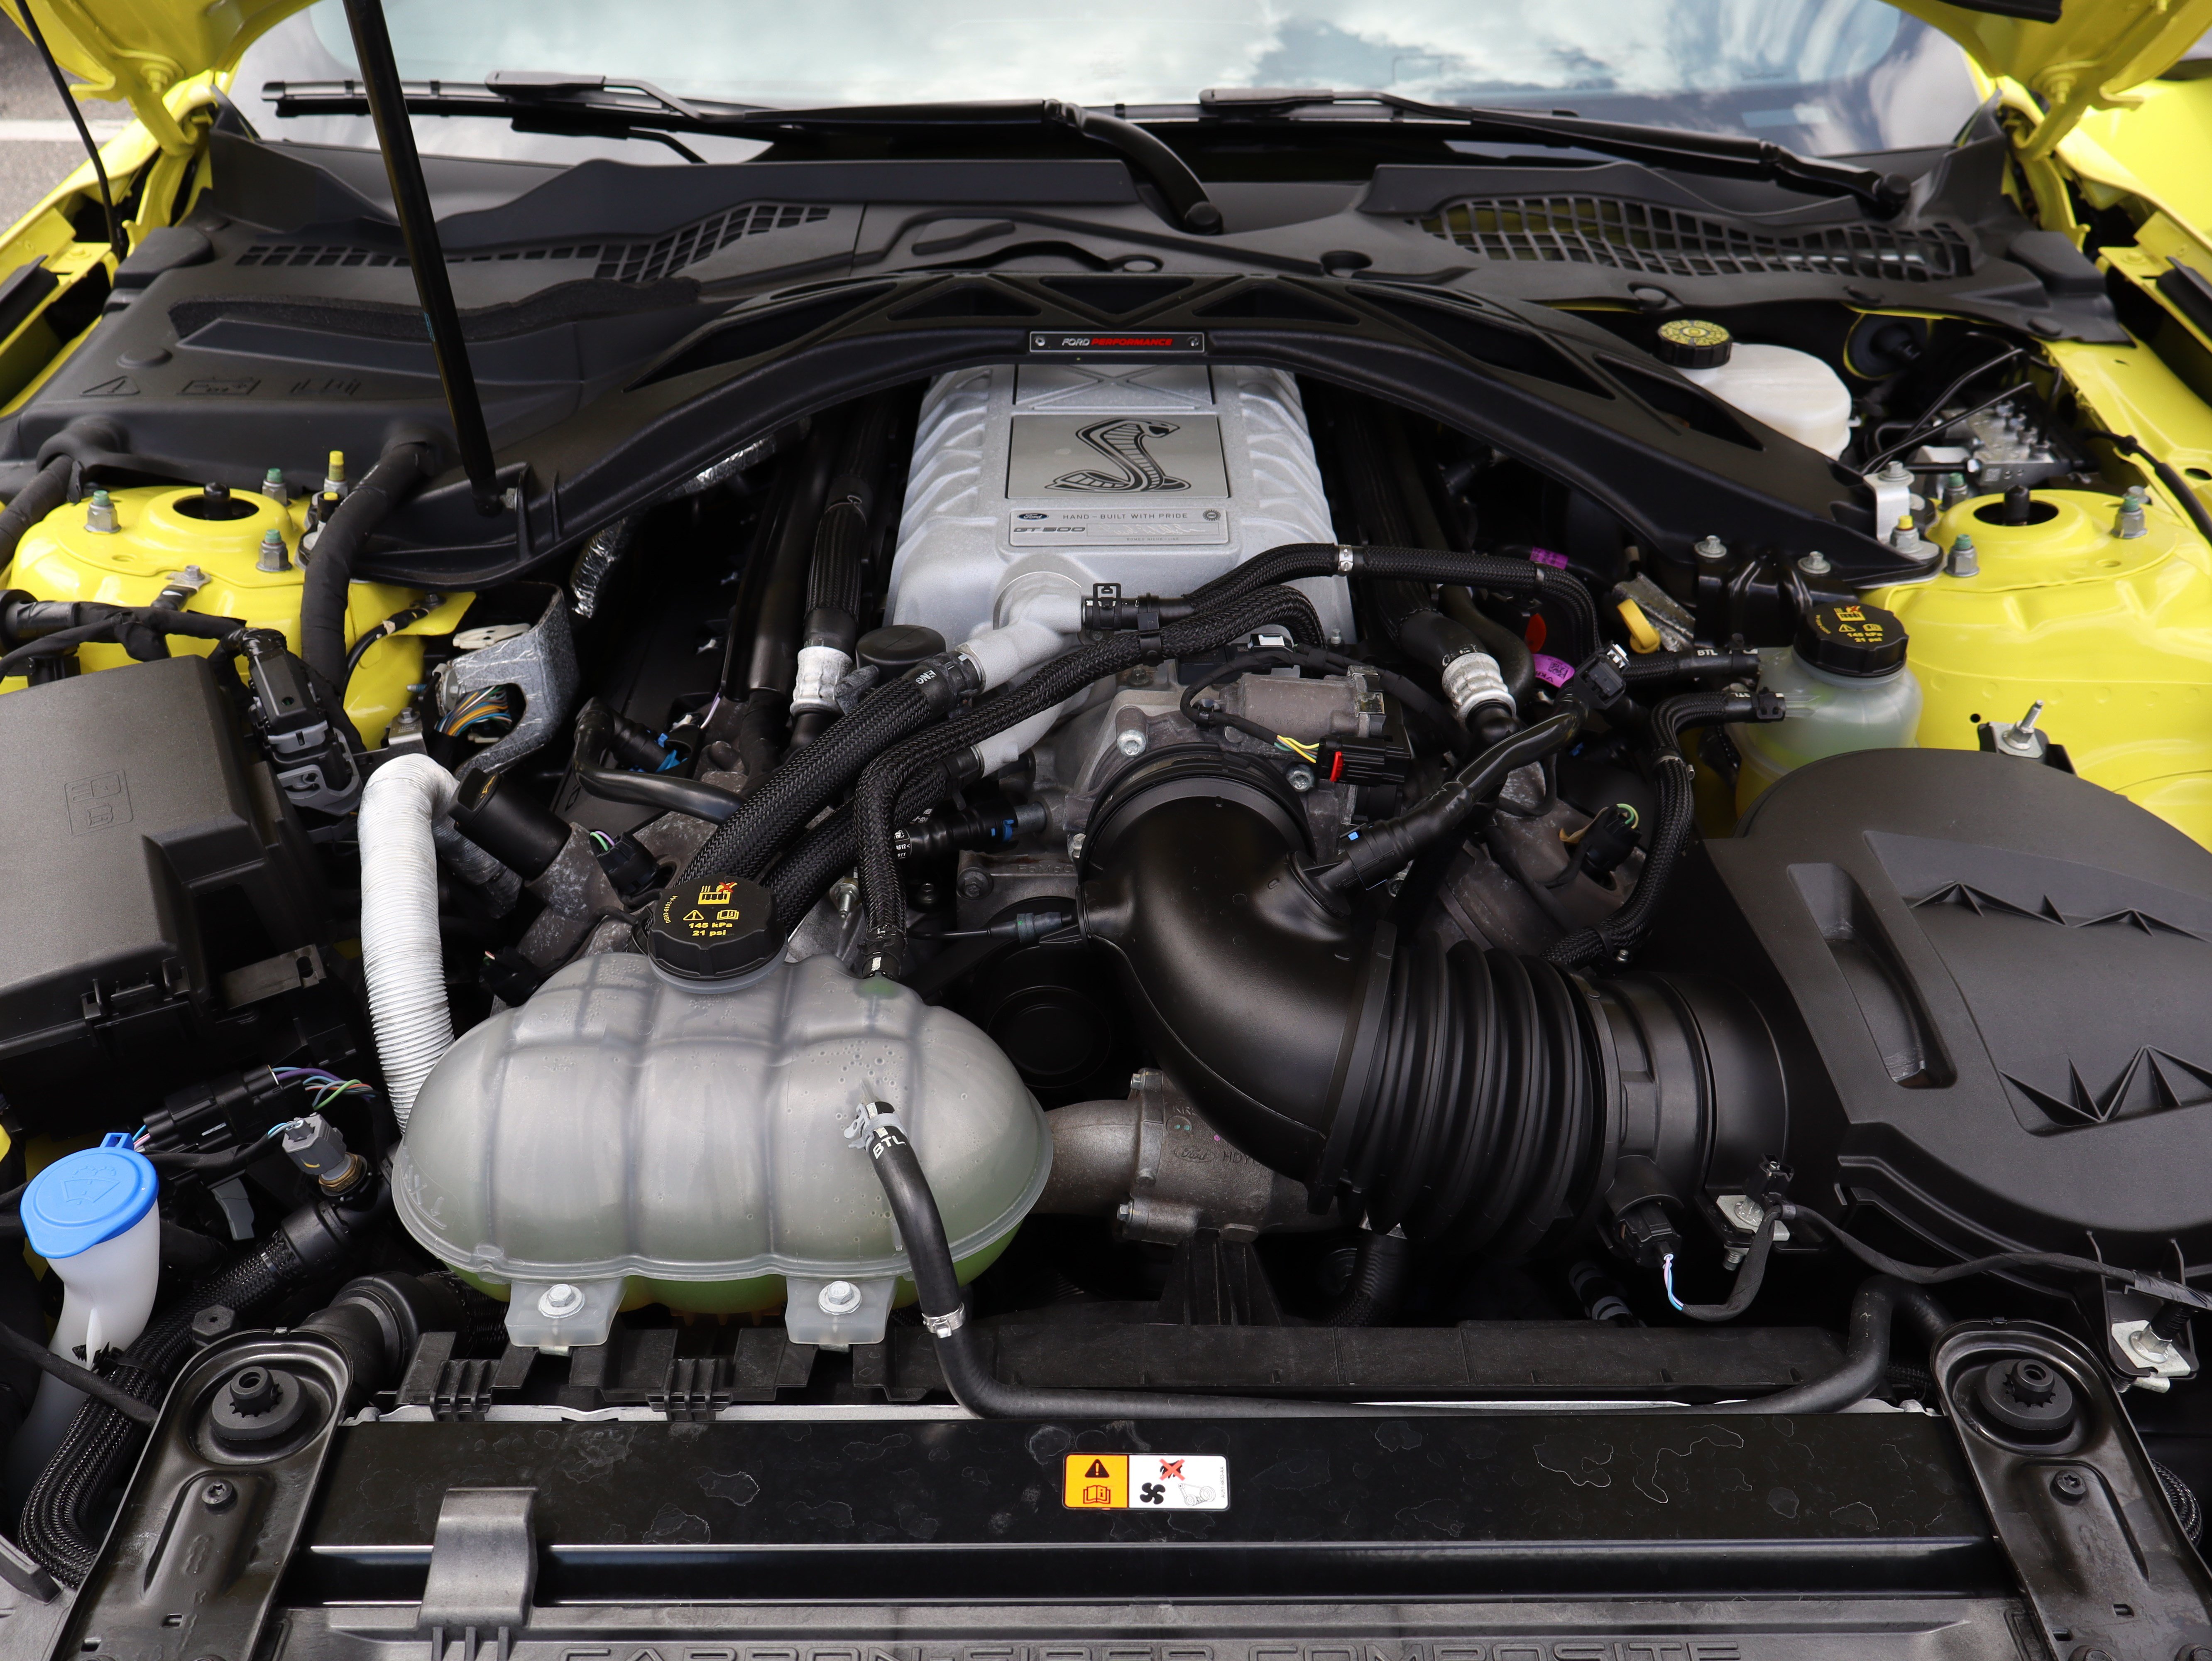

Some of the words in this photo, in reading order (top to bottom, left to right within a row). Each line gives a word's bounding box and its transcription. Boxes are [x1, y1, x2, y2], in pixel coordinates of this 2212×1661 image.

[1062, 338, 1089, 346] FORD
[1091, 338, 1173, 346] PERFORMANCE
[915, 669, 937, 685] ENG
[872, 1135, 906, 1159] BTL
